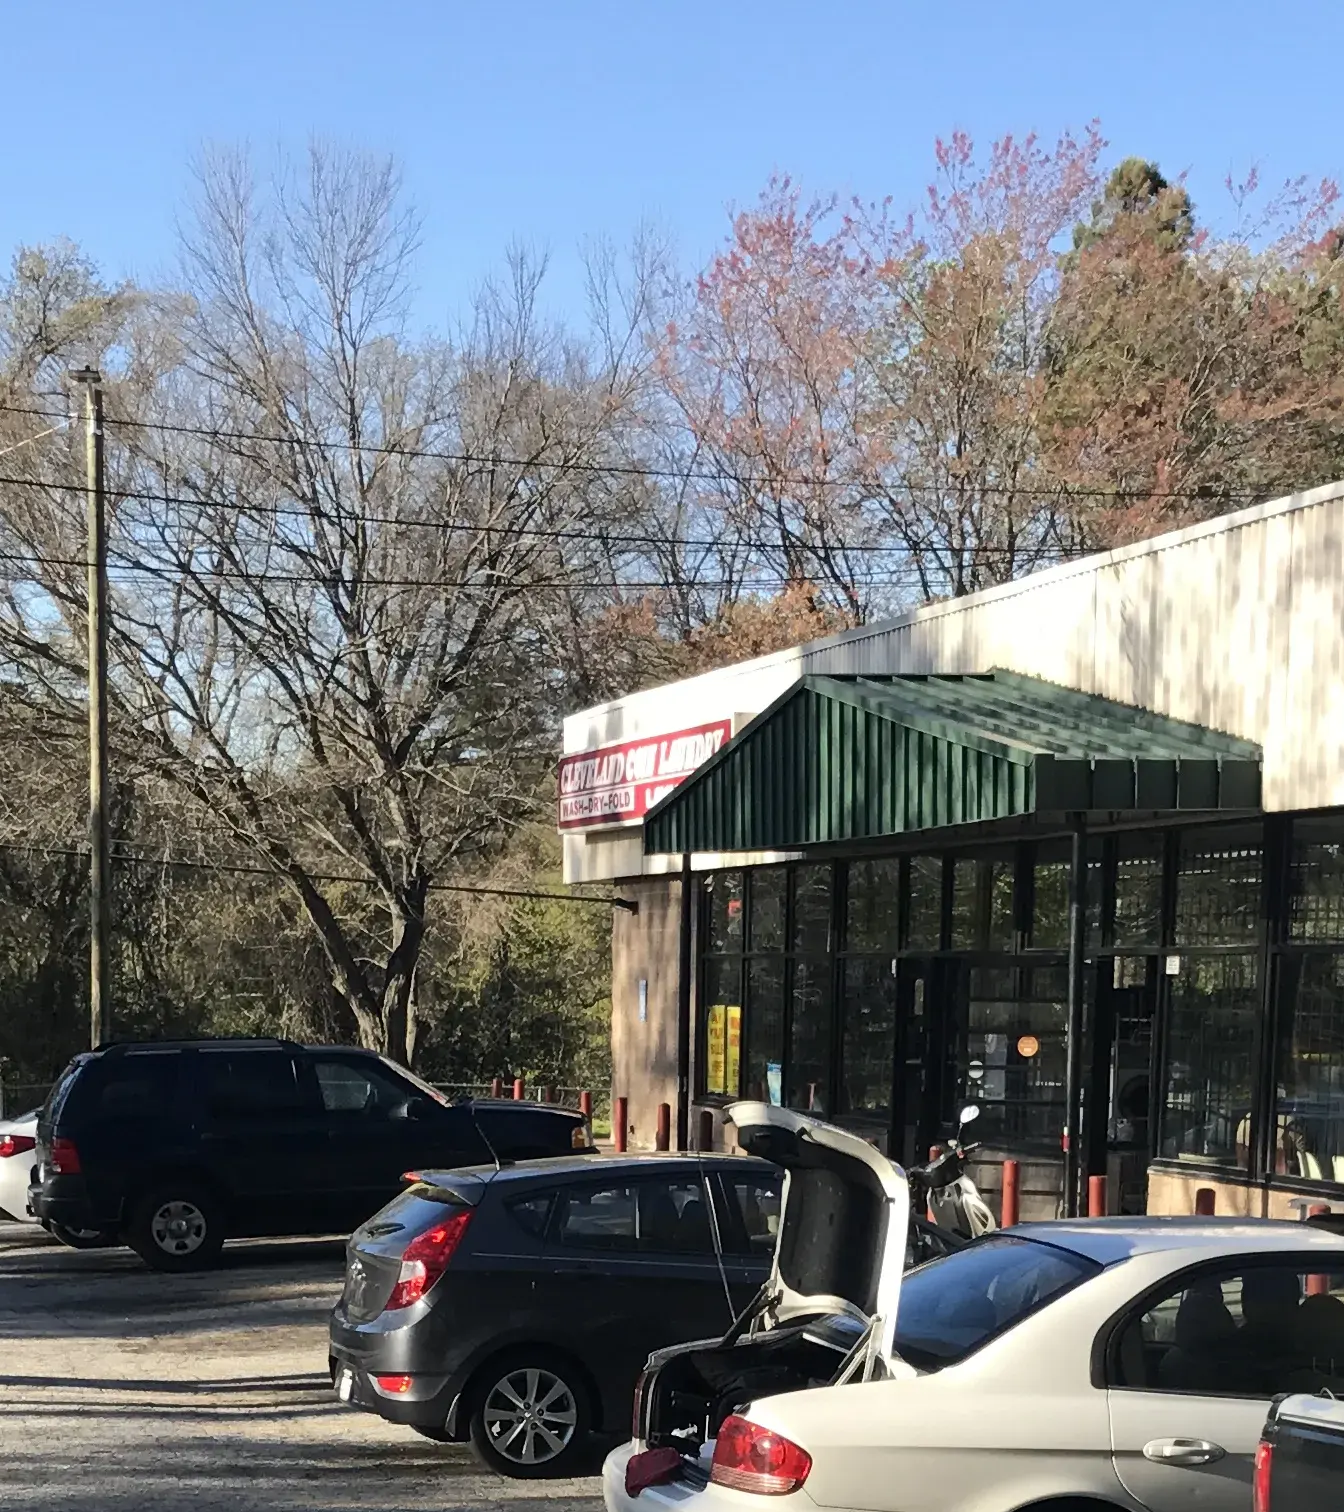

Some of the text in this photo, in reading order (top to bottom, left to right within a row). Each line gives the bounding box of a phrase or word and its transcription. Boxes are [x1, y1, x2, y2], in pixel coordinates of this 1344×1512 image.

[561, 728, 725, 794] CLEVELAND COIN LAUNDRY
[562, 790, 631, 818] WASH-DRY-FOLD
